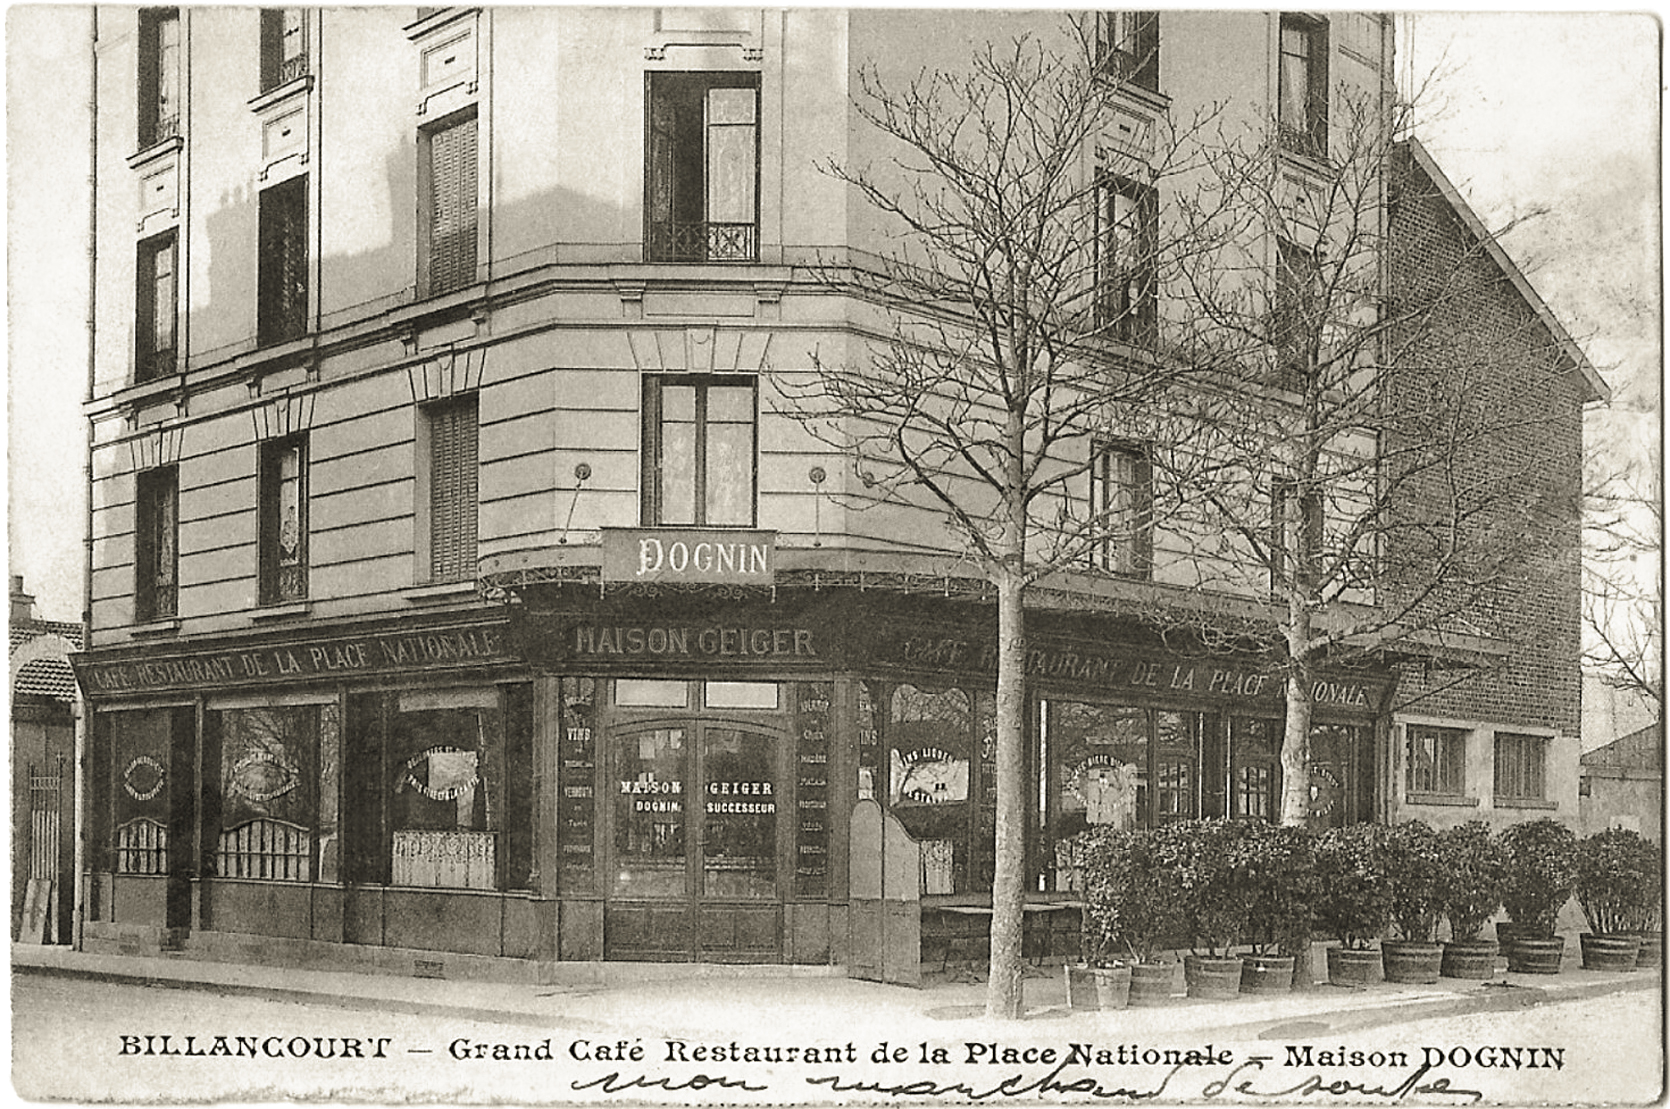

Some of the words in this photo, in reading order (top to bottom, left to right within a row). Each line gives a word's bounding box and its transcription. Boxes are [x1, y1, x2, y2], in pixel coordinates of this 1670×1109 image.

[636, 538, 769, 575] DOGNIN
[576, 628, 688, 655] MAISON
[699, 629, 816, 656] GEIGER
[136, 656, 234, 686] RESTAURANT
[241, 653, 269, 677] DE
[274, 650, 301, 674] LA
[310, 643, 367, 670] PLACE
[380, 630, 500, 665] NATIONALE
[980, 643, 1123, 681] RTAURANT
[1131, 659, 1161, 686] DE
[1169, 665, 1196, 690] LA
[1276, 676, 1369, 708] NIONALE
[859, 729, 878, 746] INS
[620, 780, 682, 794] MAISON
[709, 782, 773, 795] GEIGER
[636, 801, 682, 812] DOGNIN
[706, 803, 776, 814] SUCCESSEUR
